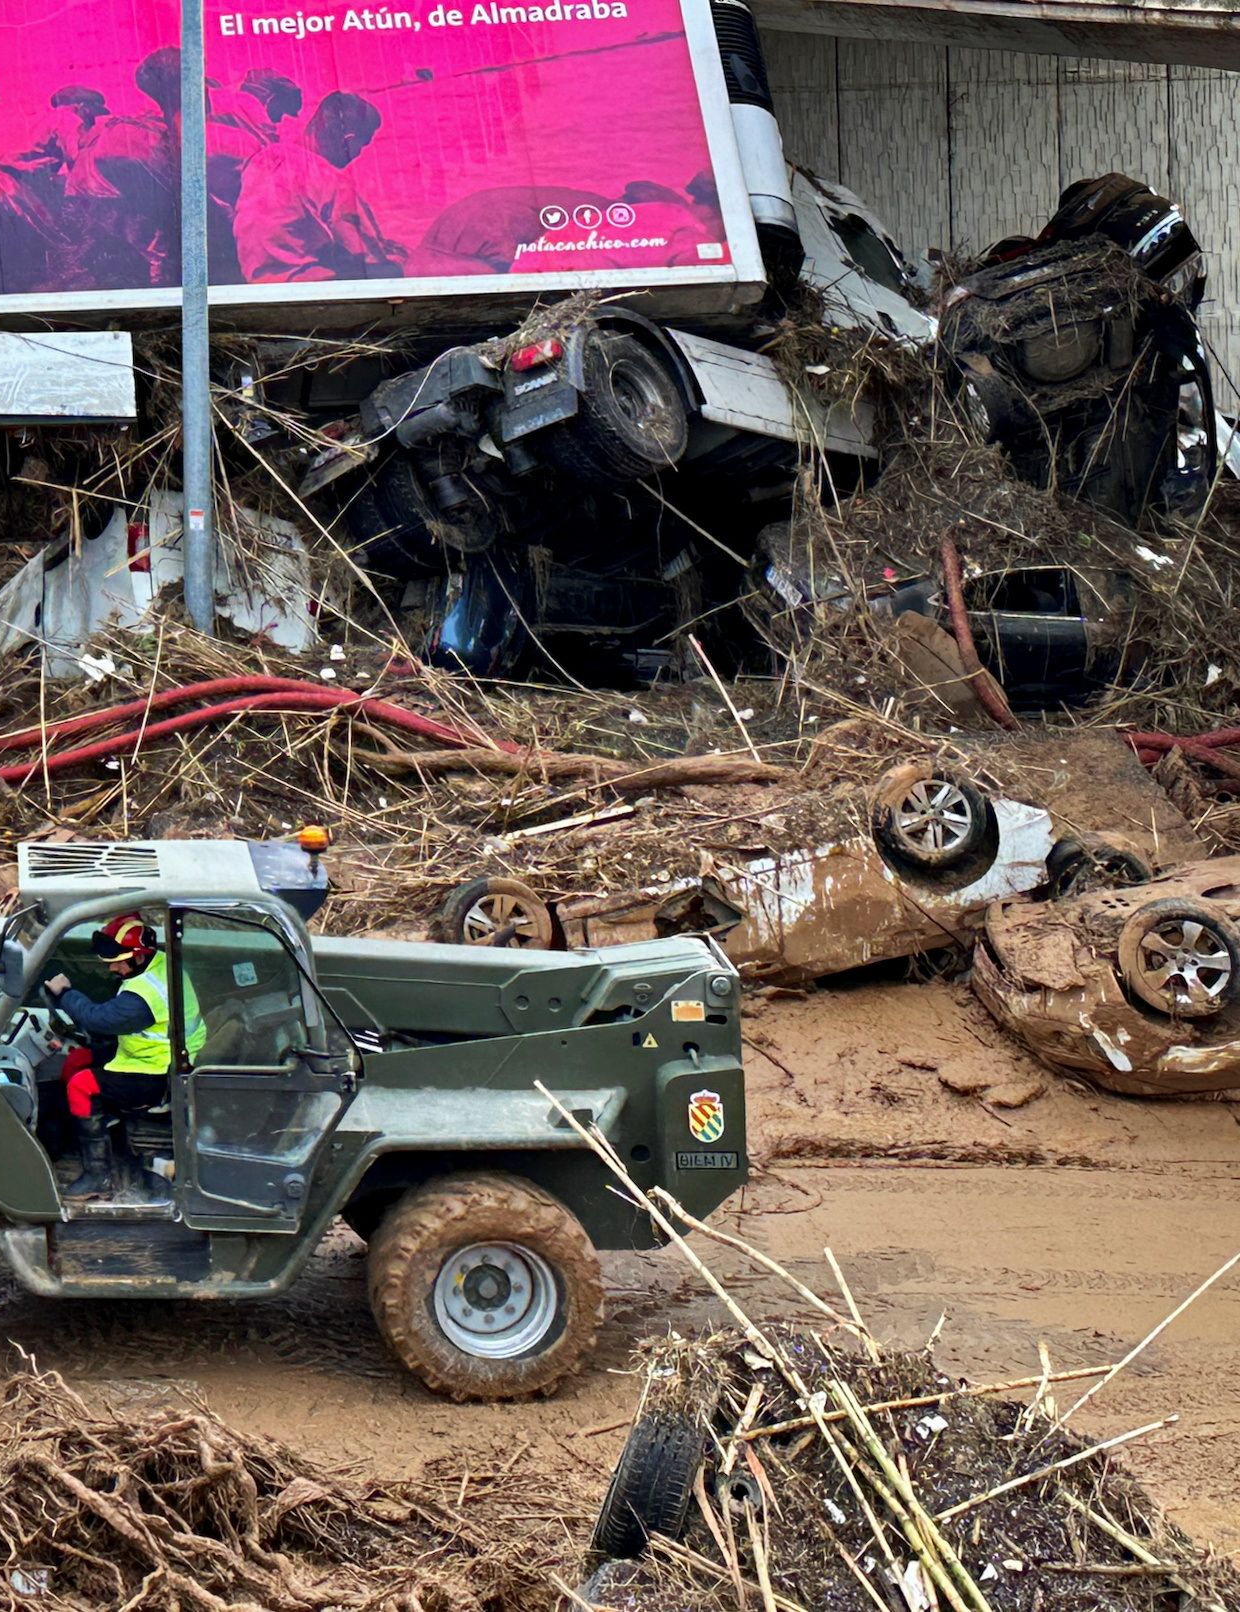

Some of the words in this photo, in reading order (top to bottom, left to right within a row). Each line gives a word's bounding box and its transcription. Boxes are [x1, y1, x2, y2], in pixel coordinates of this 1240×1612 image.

[220, 13, 244, 36] El
[252, 11, 335, 40] mejor
[342, 7, 421, 32] Atún,
[428, 5, 463, 27] de
[470, 0, 628, 25] Almadraba
